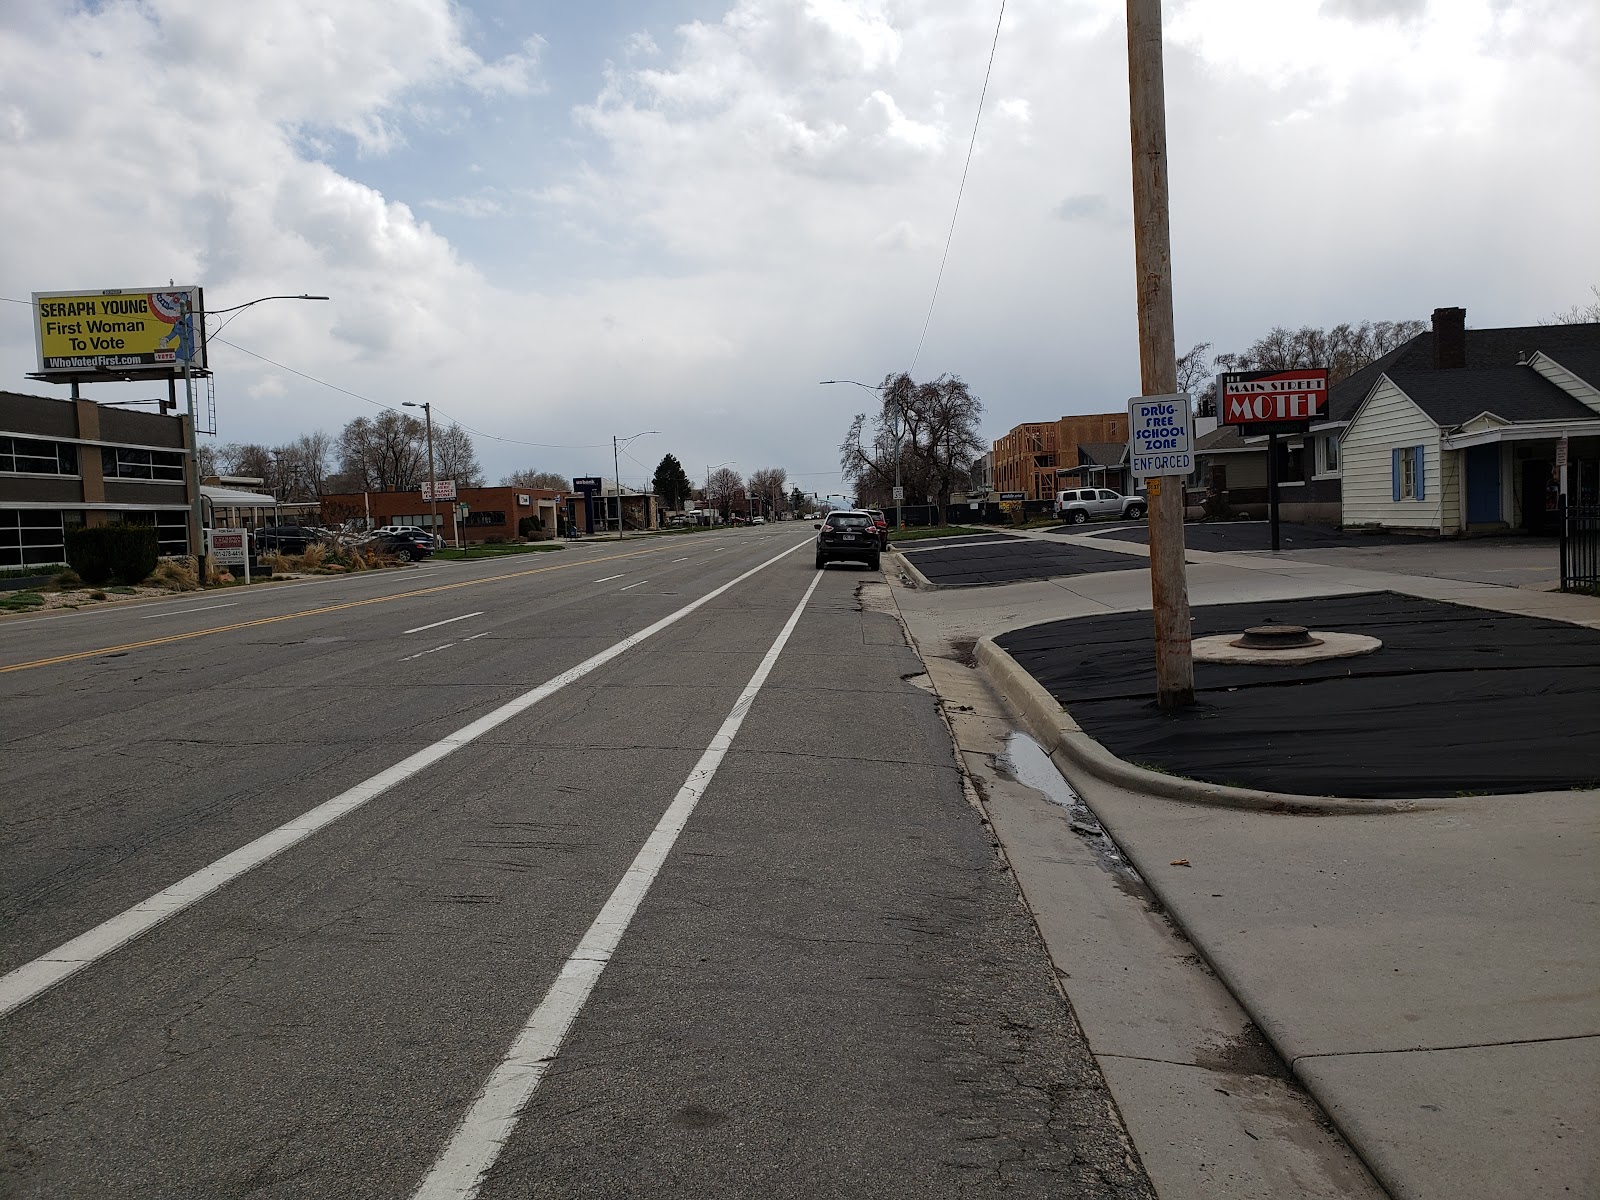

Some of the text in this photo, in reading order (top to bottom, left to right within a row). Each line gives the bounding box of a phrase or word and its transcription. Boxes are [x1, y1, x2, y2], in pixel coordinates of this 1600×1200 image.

[41, 299, 148, 318] SERAPH YOUNG
[46, 320, 145, 336] First Woman
[69, 336, 125, 351] To Vote
[49, 355, 141, 368] WhoVotedFirst.com
[1228, 379, 1324, 393] MAIN STREET
[1141, 404, 1178, 417] DRUG-
[1228, 393, 1325, 420] MOTEL
[1146, 416, 1174, 428] FREE
[1136, 426, 1185, 440] SCHOOL
[1144, 438, 1177, 450] ZONE
[1133, 454, 1190, 471] ENFORCED
